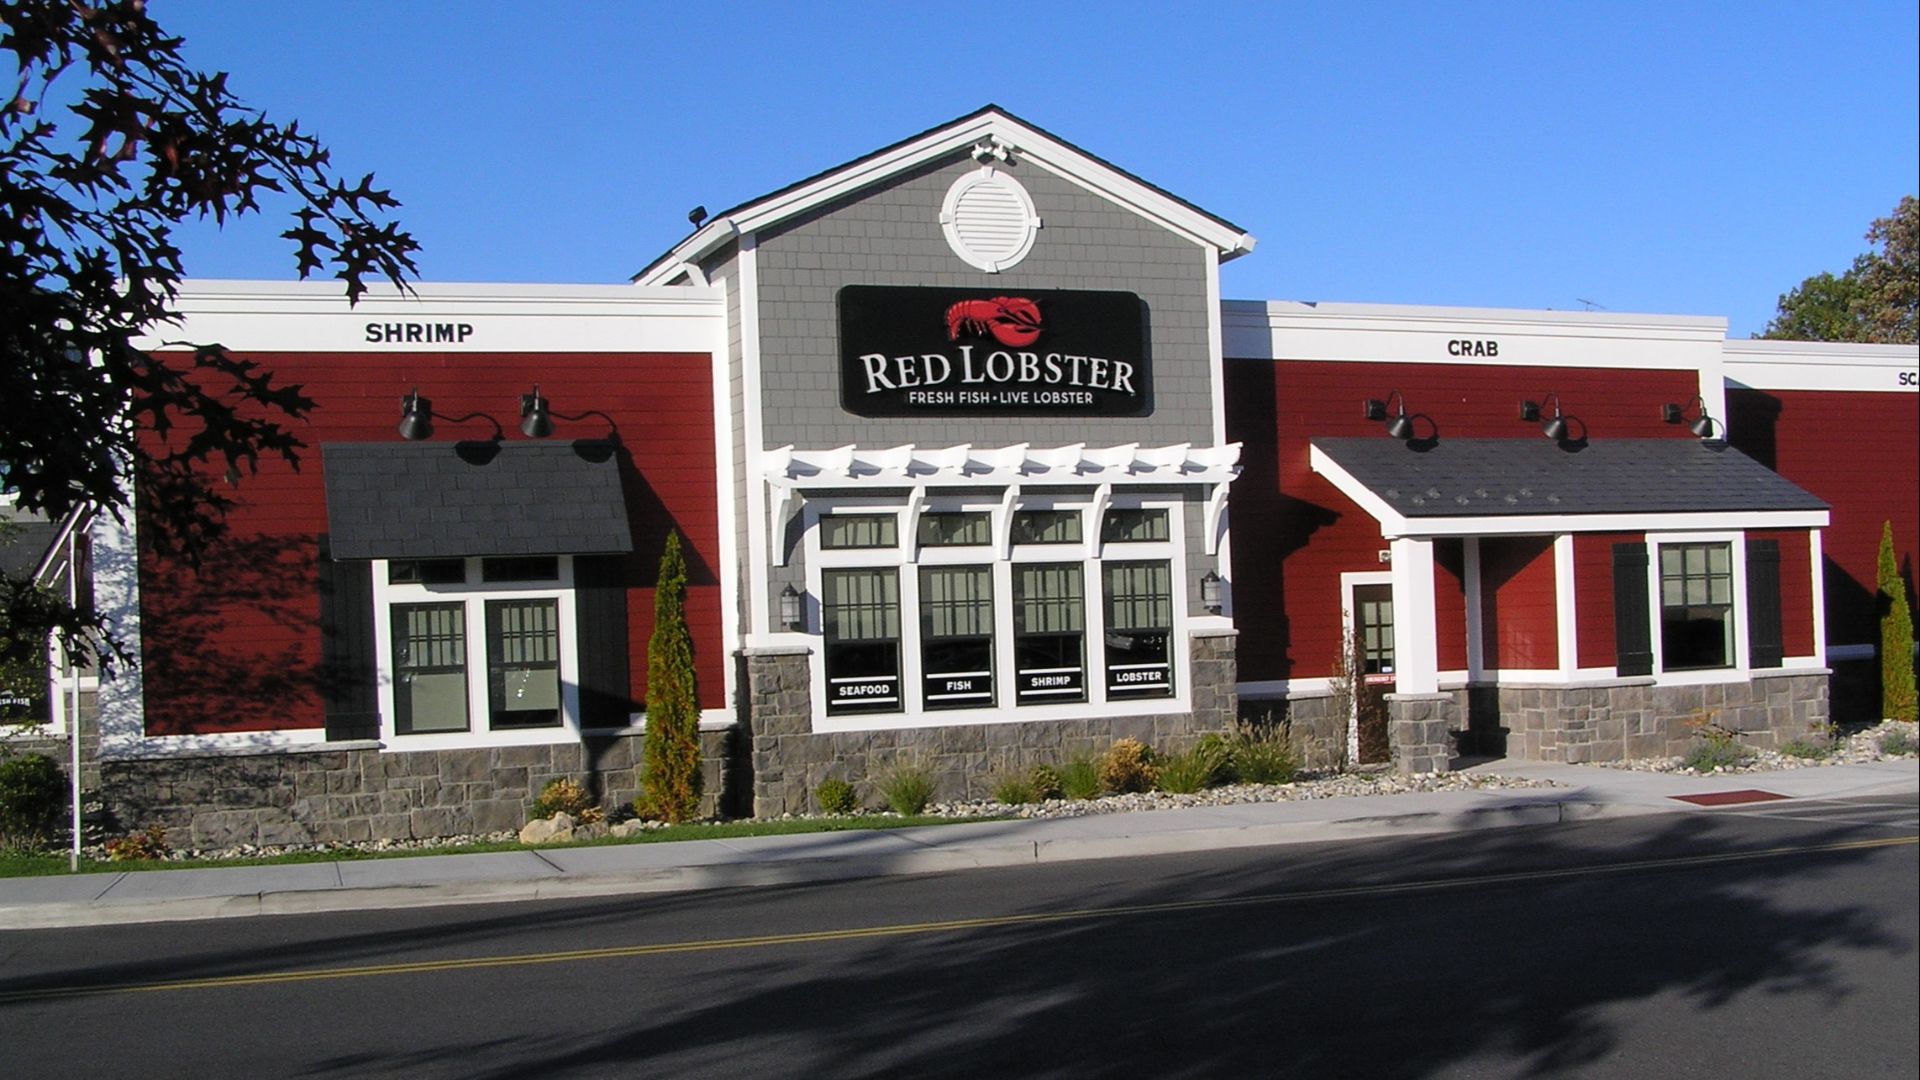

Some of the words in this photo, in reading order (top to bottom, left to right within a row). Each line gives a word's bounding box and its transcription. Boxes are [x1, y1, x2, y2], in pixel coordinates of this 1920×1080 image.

[365, 322, 473, 343] SHRIMP
[1447, 339, 1498, 357] CRAB
[860, 353, 951, 393] RED
[959, 345, 1135, 394] LOBSTER
[1899, 372, 1919, 386] SC
[909, 391, 954, 404] FRESH
[959, 391, 990, 404] FISH
[1000, 391, 1029, 404] LIVE
[1033, 391, 1093, 404] LOBSTER
[1031, 676, 1071, 687] SHRIMP
[1116, 671, 1162, 683] LOBSTER
[839, 684, 890, 696] SEAFOOD
[946, 680, 972, 691] FISH
